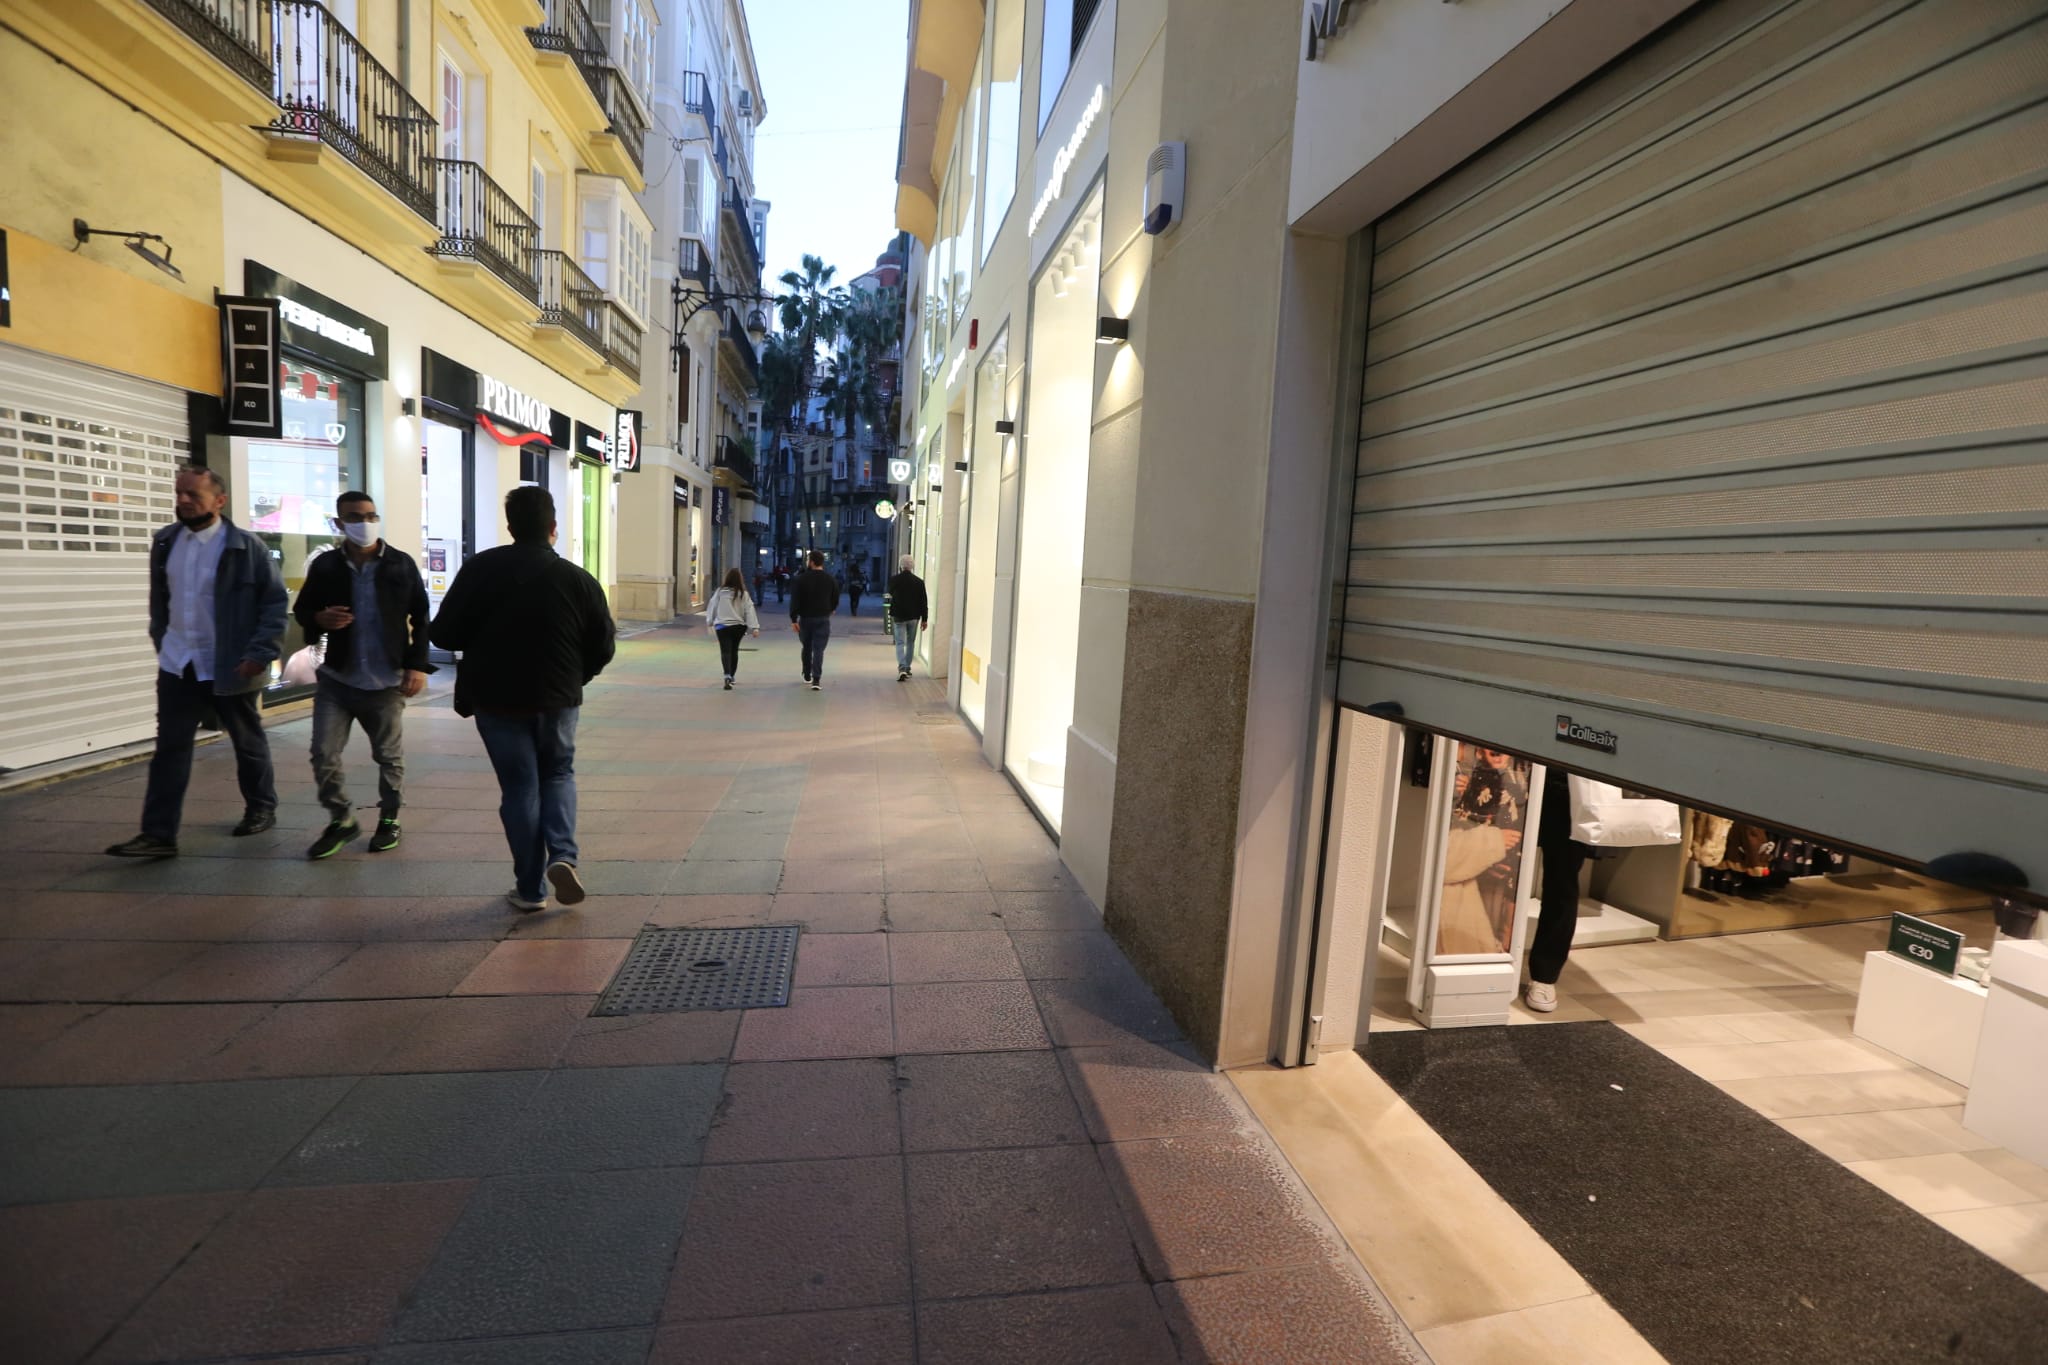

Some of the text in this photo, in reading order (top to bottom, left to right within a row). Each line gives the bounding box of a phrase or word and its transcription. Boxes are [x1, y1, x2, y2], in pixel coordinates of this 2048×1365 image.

[480, 374, 553, 436] PRIMOR
[617, 412, 632, 469] PRIMOR
[1907, 943, 1934, 961] €30
